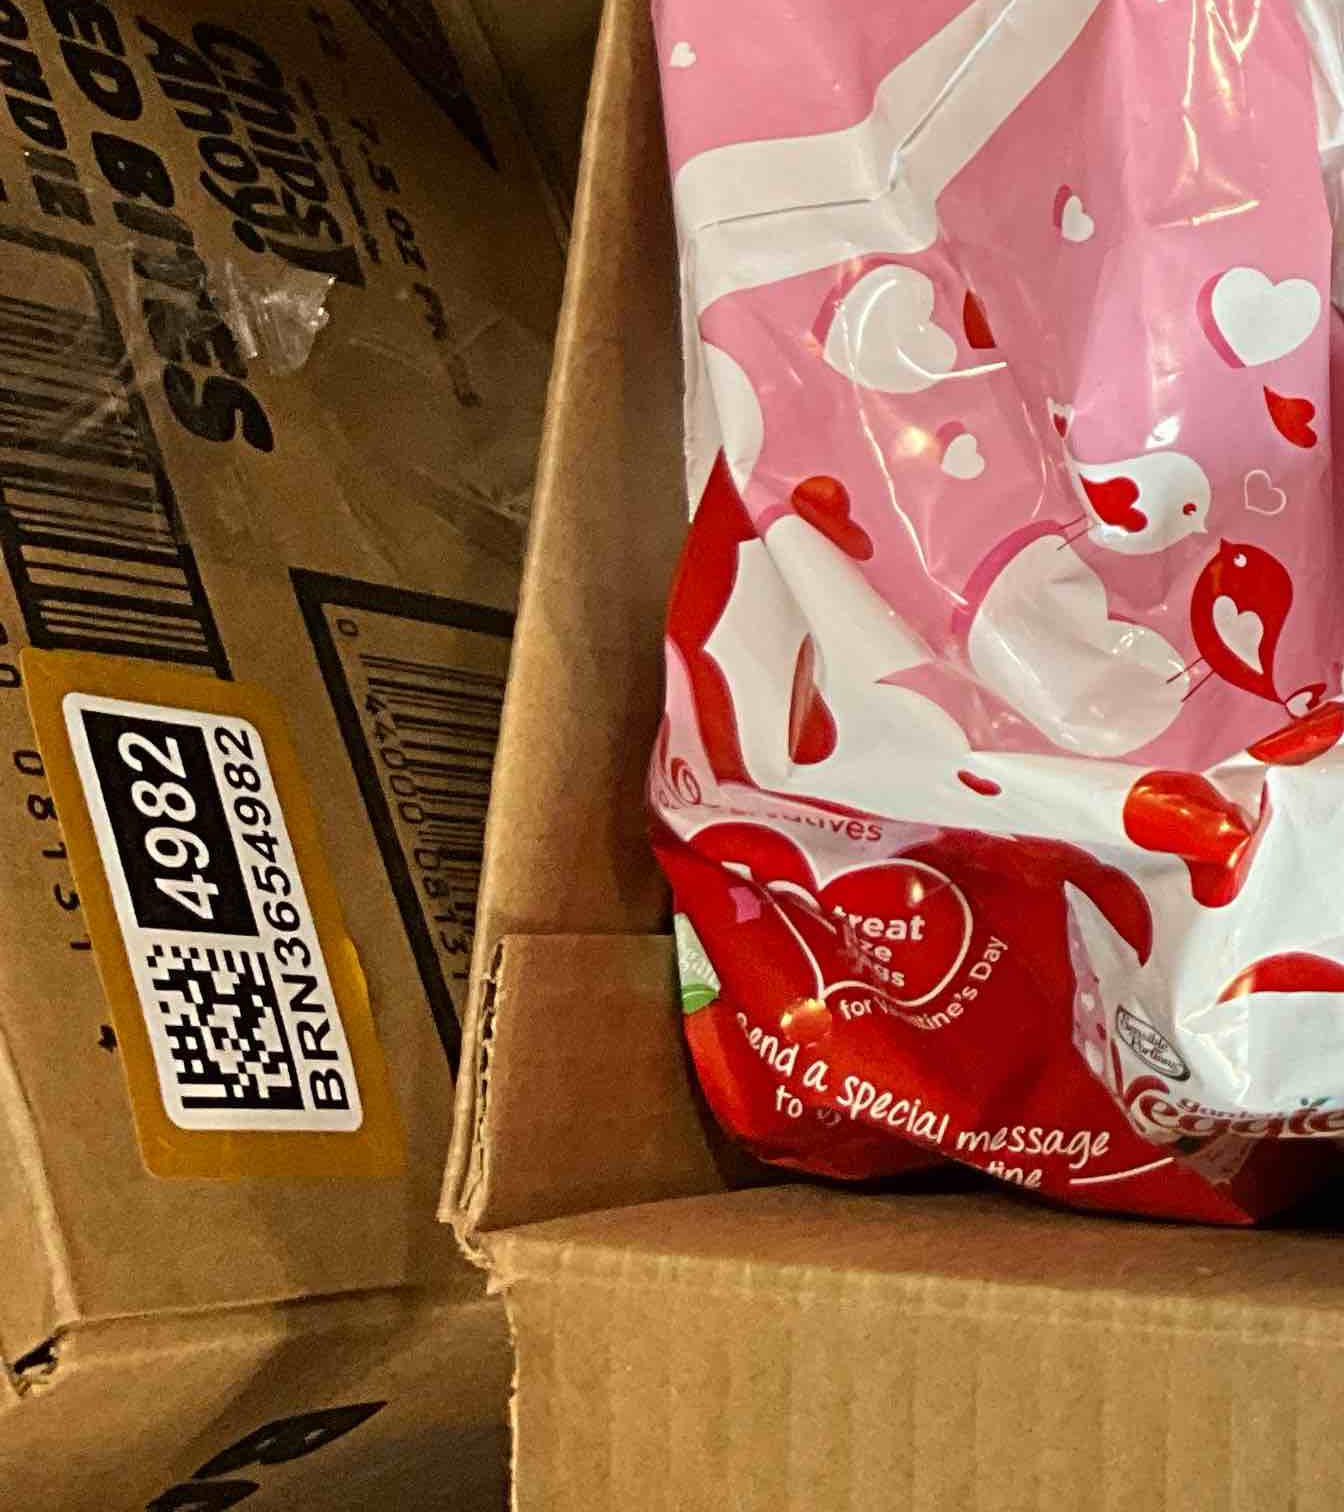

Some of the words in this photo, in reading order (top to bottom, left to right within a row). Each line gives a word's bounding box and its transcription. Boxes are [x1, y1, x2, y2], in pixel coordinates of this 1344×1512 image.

[117, 730, 220, 921] 4982
[213, 725, 351, 1111] BRN3654982
[839, 997, 872, 1022] for
[969, 934, 1010, 983] Day
[773, 1084, 804, 1120] to
[802, 1058, 829, 1092] a
[836, 1073, 951, 1146] special
[955, 1124, 1111, 1171] message
